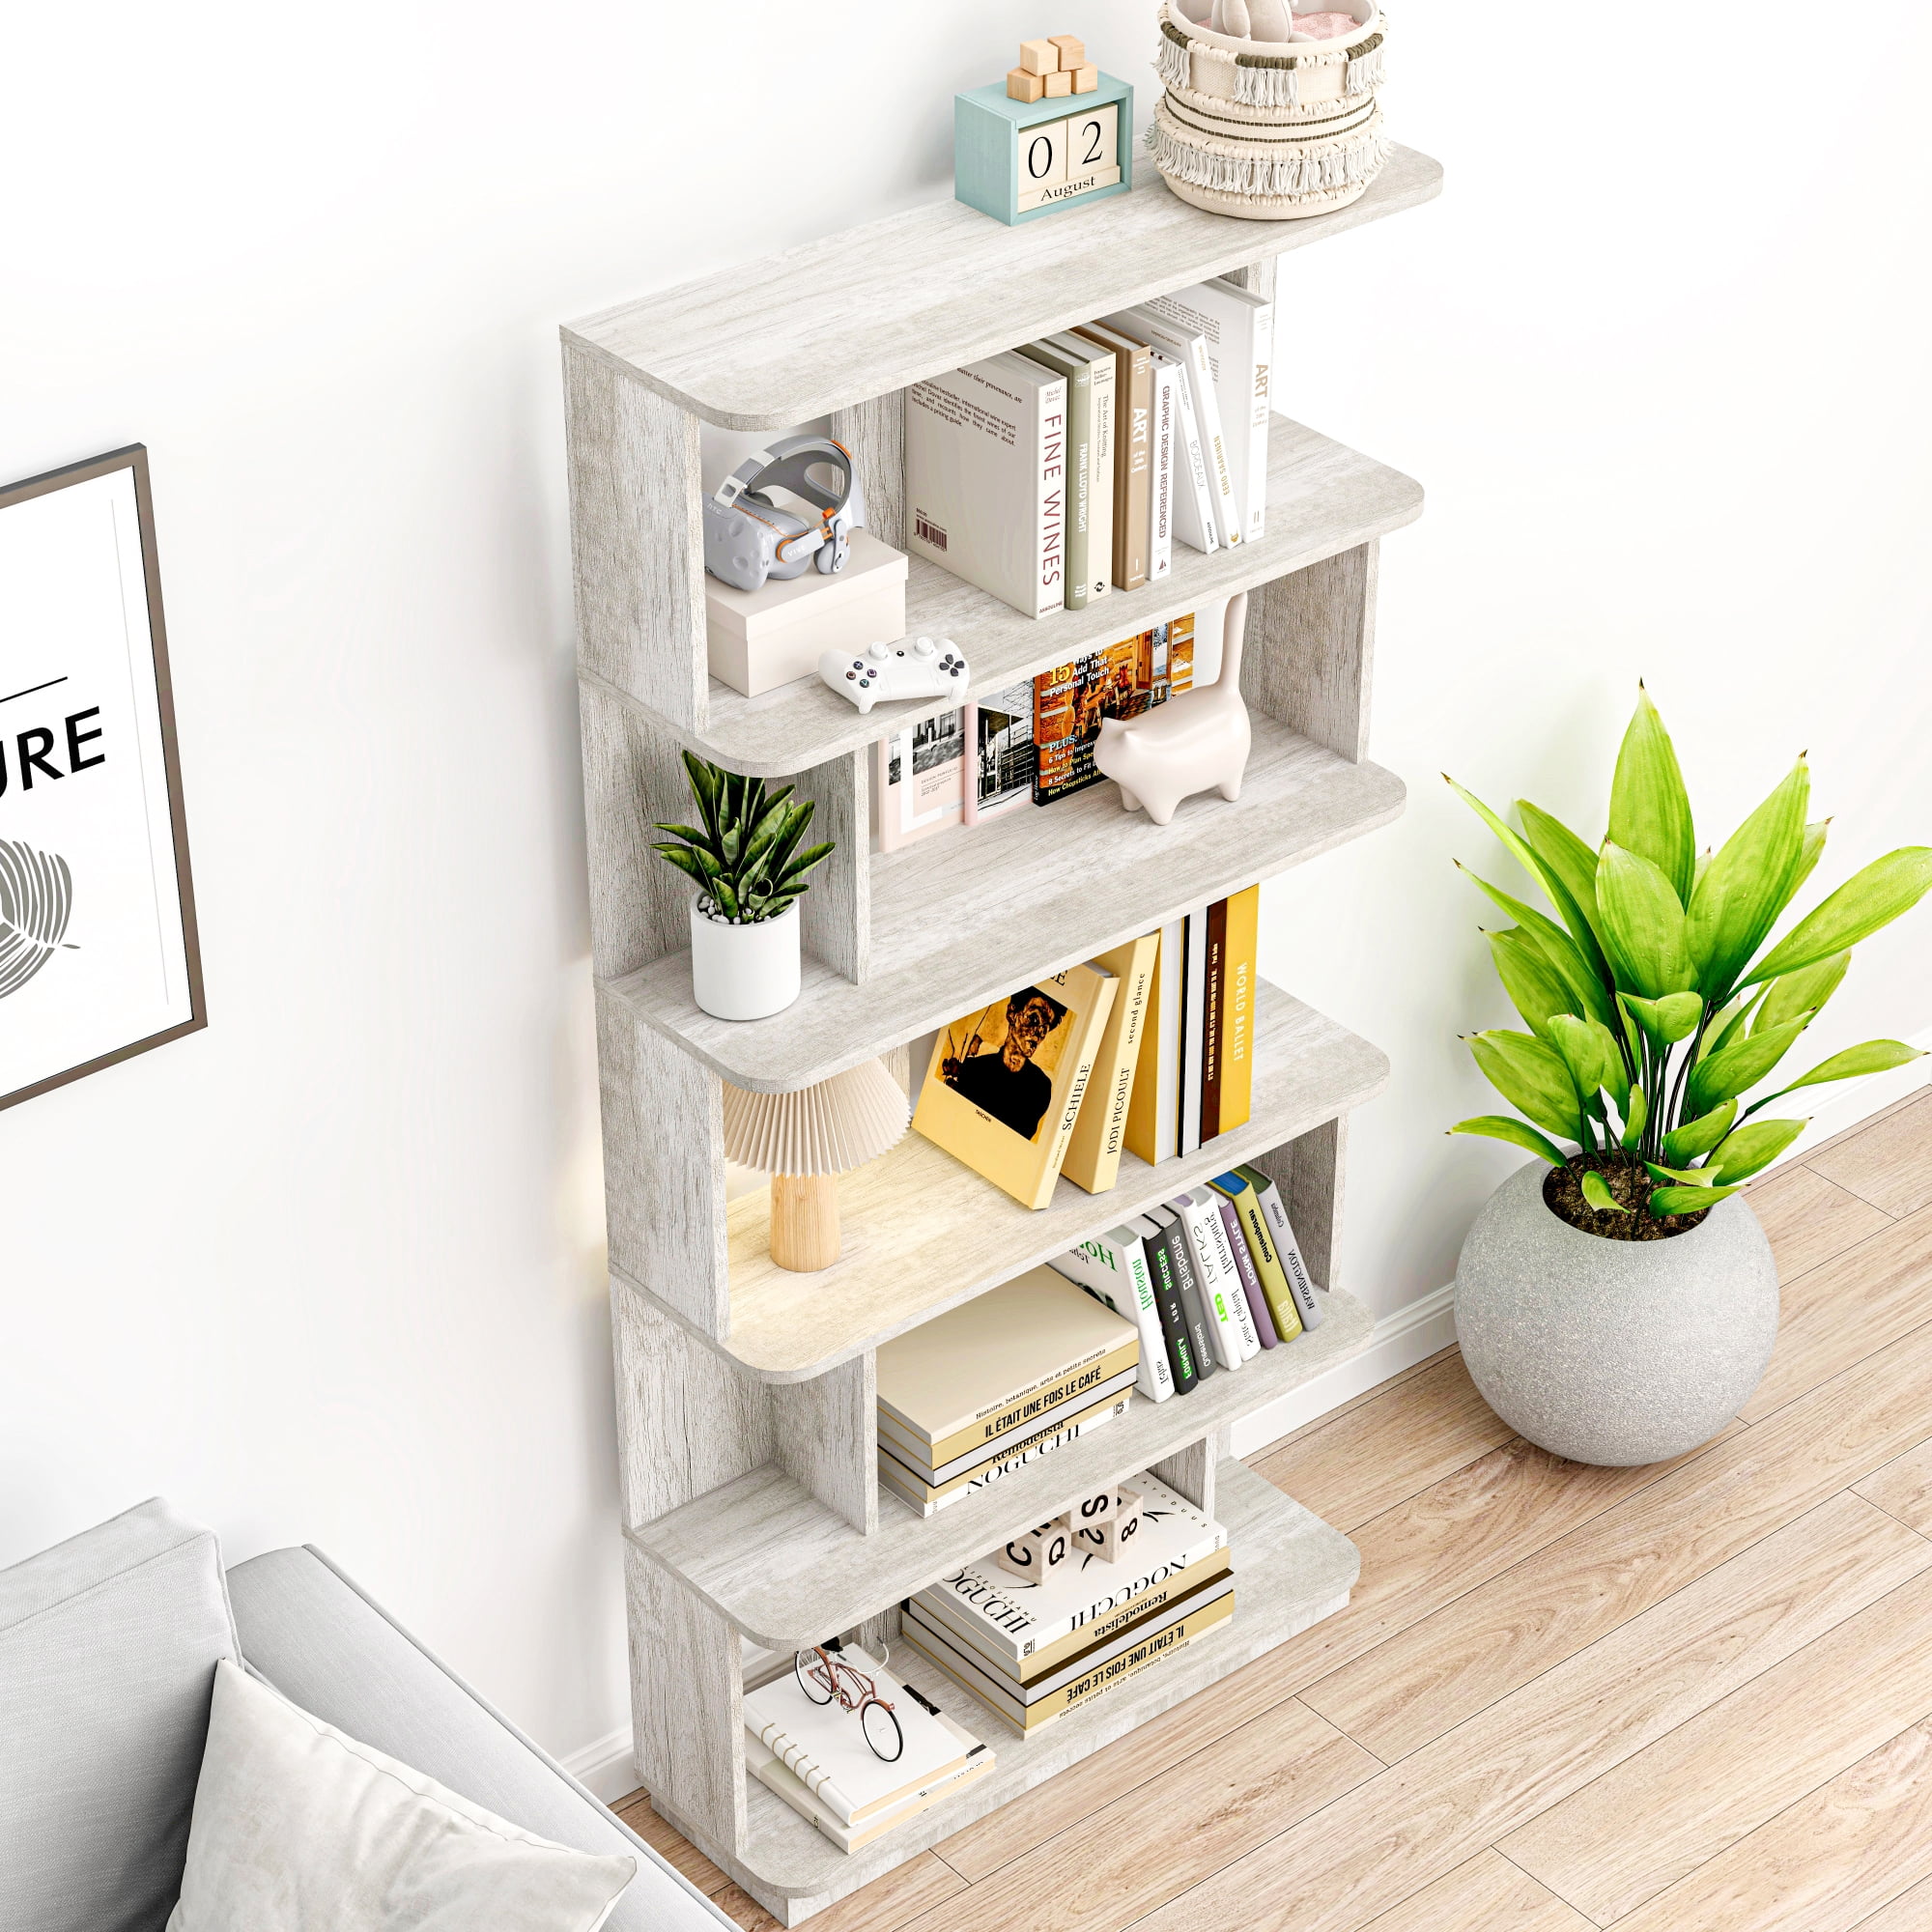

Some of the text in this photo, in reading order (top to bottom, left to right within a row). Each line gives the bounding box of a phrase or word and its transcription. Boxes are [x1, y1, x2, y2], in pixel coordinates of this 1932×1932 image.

[1082, 121, 1103, 165] 2
[1040, 176, 1095, 202] August
[1255, 364, 1268, 398] ART
[1133, 409, 1148, 443] ART
[1213, 436, 1230, 496] EERO SAARINEN
[1043, 414, 1062, 585] FINE WINES
[1078, 443, 1088, 533] FRANK LLOYD WRIGHT
[1159, 473, 1168, 538] REFERENCED
[1049, 666, 1110, 697] Personal Touch
[1050, 667, 1070, 686] 15
[1072, 656, 1108, 676] Add That
[1049, 734, 1078, 753] PLUS:
[1055, 753, 1066, 761] Tips
[1075, 741, 1095, 753] Improv
[1048, 766, 1062, 775] How
[1055, 771, 1075, 781] Secrets
[1048, 787, 1061, 797] How
[1128, 973, 1146, 1044] second glance
[1234, 962, 1247, 1061] WORLD BALLET
[1063, 1064, 1090, 1130] SCHIELE
[1107, 1068, 1130, 1154] JODI PICOULT
[976, 1402, 1004, 1420] Histoire,
[1006, 1384, 1038, 1404] botanique,
[1040, 1376, 1054, 1389] arts
[1063, 1360, 1082, 1376] petits
[1083, 1349, 1106, 1364] secrets
[985, 1365, 1101, 1438] IL ÉTAIT UNE FOIS LE CAFÉ
[967, 1424, 1079, 1494] NOGUCHI
[1122, 1518, 1138, 1542] 8
[1049, 1537, 1065, 1566] Q
[943, 1568, 1031, 1634] OGUCHI
[1071, 1554, 1187, 1632] NOGUCHI
[1094, 1591, 1167, 1637] Remodelista
[1066, 1625, 1184, 1703] IL ÉTAIT UNE FOIS LE CAFÉ
[1128, 1657, 1161, 1678] botanique,
[1085, 1690, 1103, 1705] petits
[1113, 1676, 1127, 1688] arts
[1059, 1702, 1083, 1718] secrets
